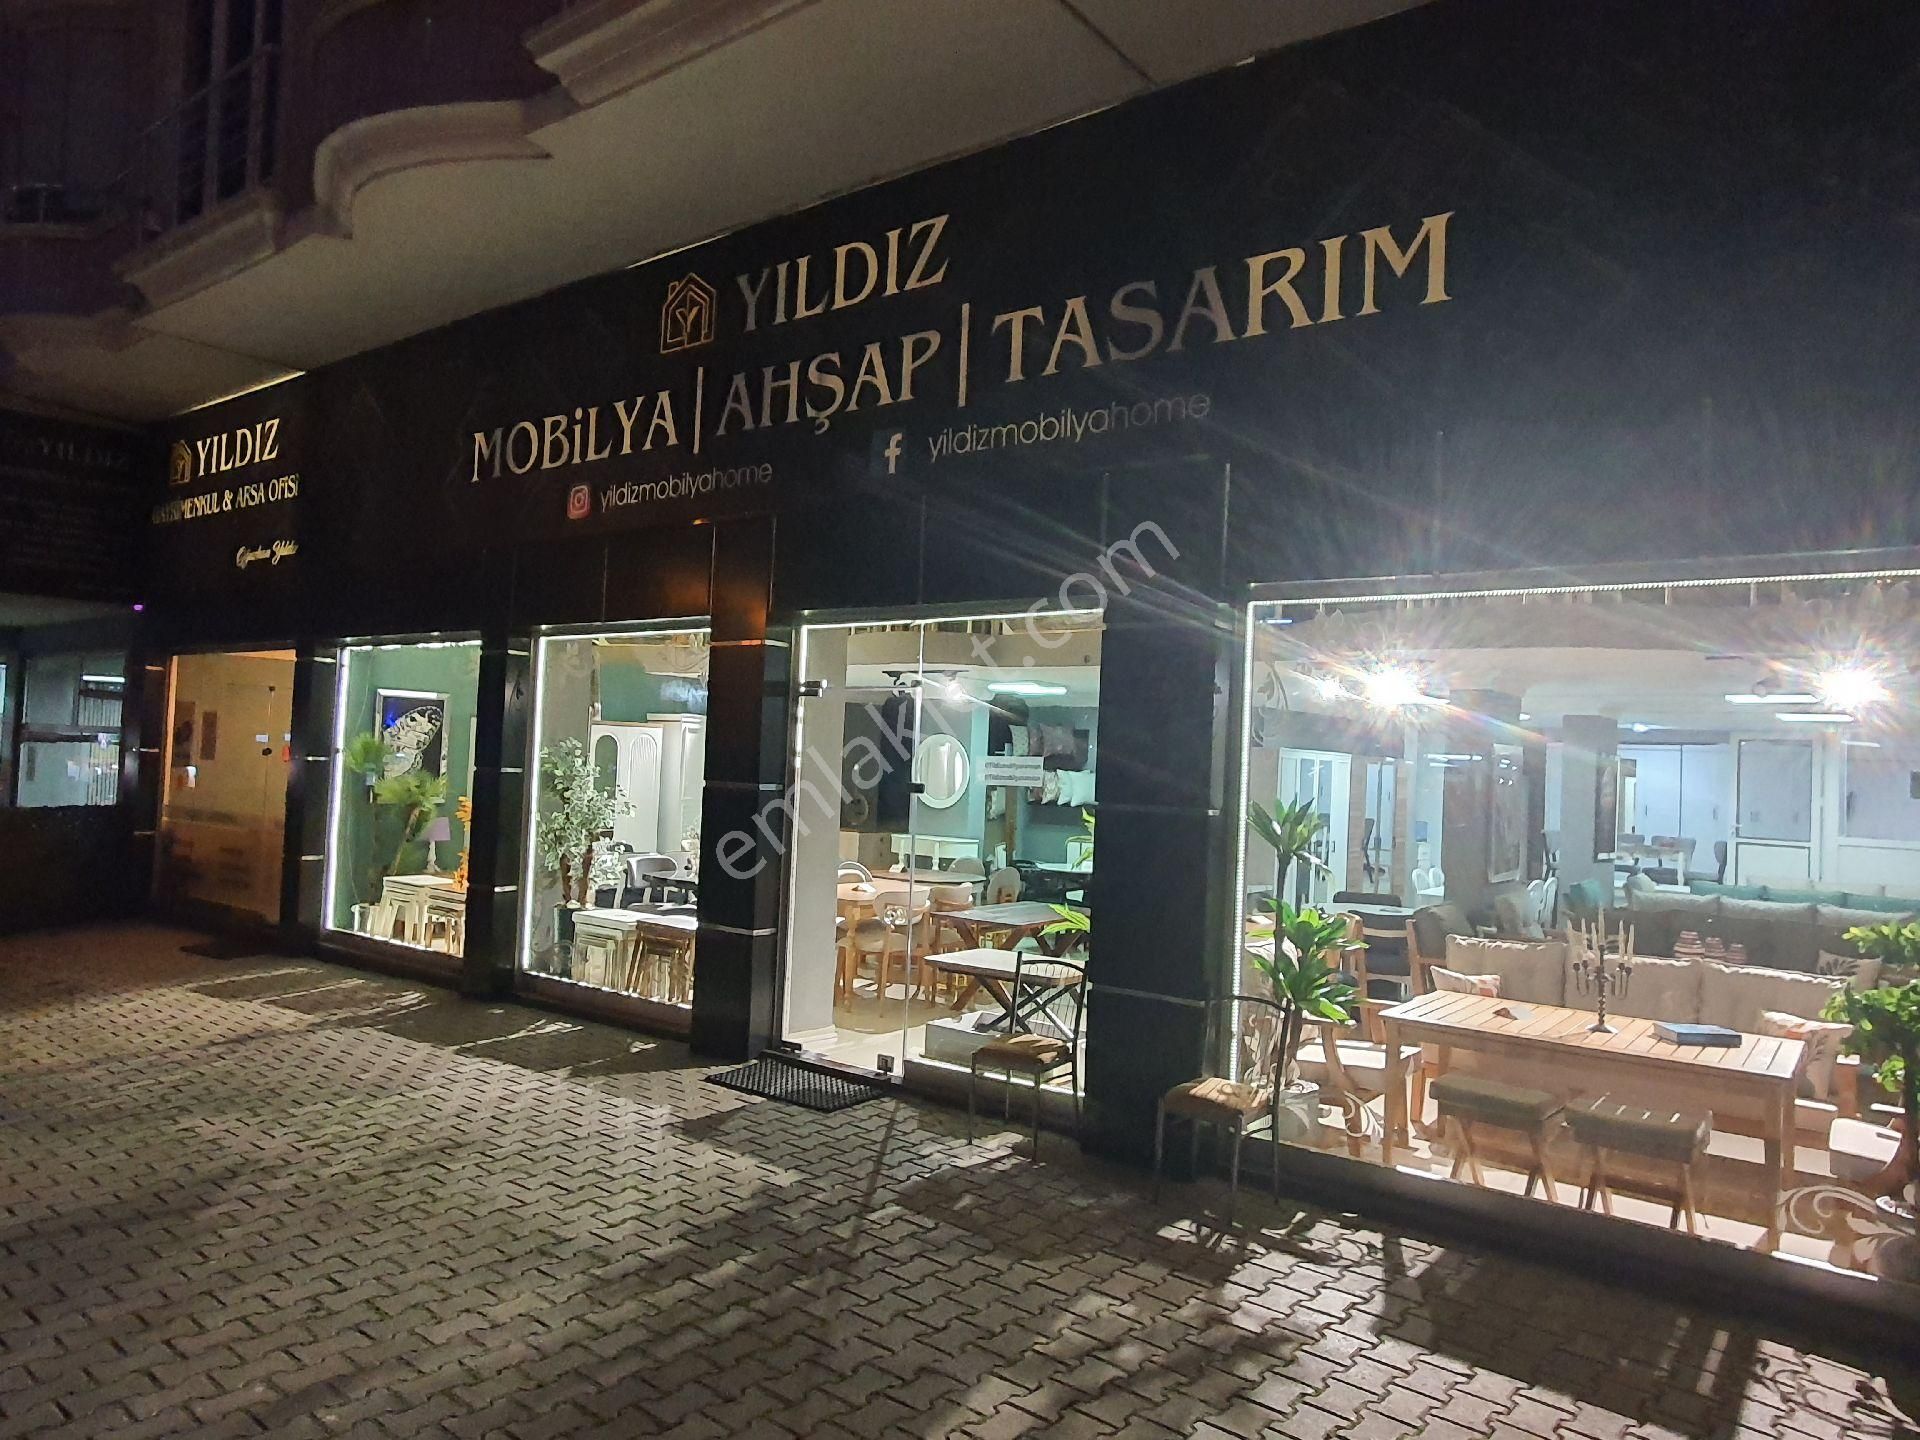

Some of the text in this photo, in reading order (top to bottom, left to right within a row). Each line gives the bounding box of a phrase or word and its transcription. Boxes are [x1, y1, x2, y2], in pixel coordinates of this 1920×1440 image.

[735, 214, 951, 333] YILDIZ
[716, 330, 941, 435] AHŞAP
[991, 211, 1455, 383] TASARIM
[196, 417, 281, 478] YILDIZ
[928, 393, 1211, 463] yildizmobilyahome
[222, 489, 234, 511] &
[235, 482, 265, 508] ARSA
[602, 463, 774, 513] yildizmobilyahome
